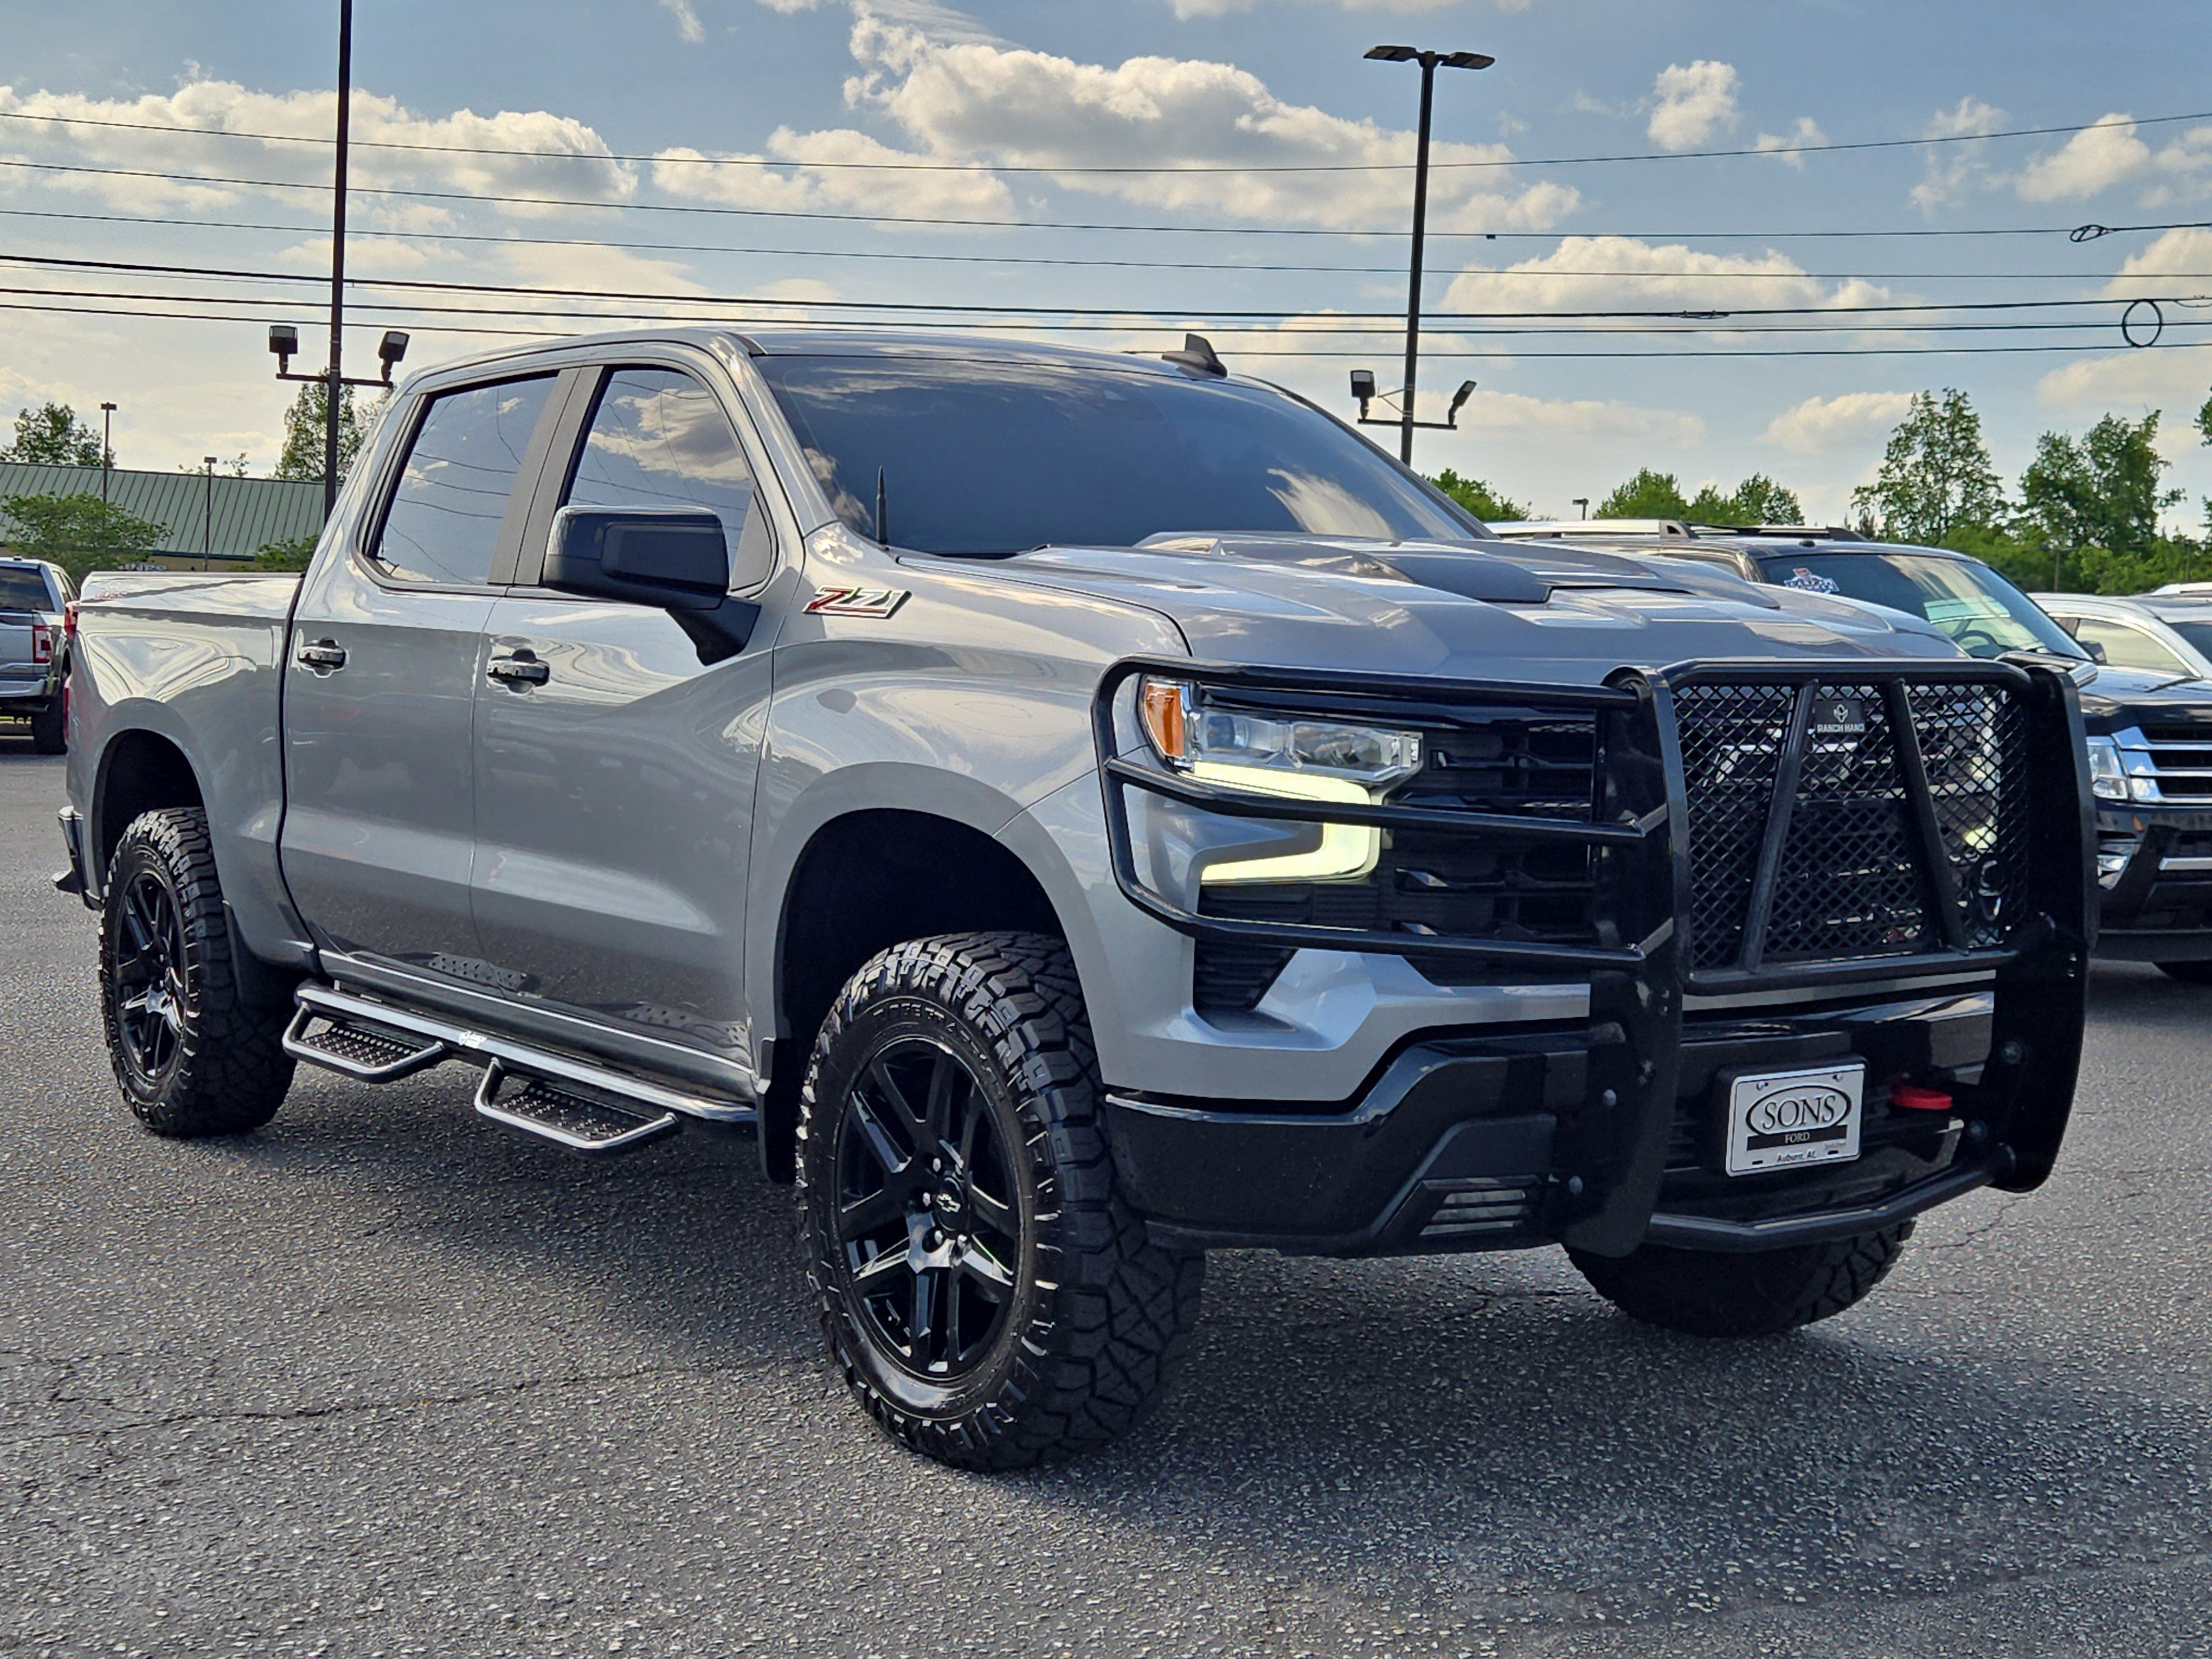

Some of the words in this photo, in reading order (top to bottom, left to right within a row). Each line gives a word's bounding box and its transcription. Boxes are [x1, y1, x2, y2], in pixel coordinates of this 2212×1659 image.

[802, 584, 908, 618] Z71
[1817, 723, 1843, 732] RANCH
[1844, 723, 1865, 732] HAND
[1762, 1095, 1836, 1129] SONS
[1785, 1132, 1810, 1143] FORD
